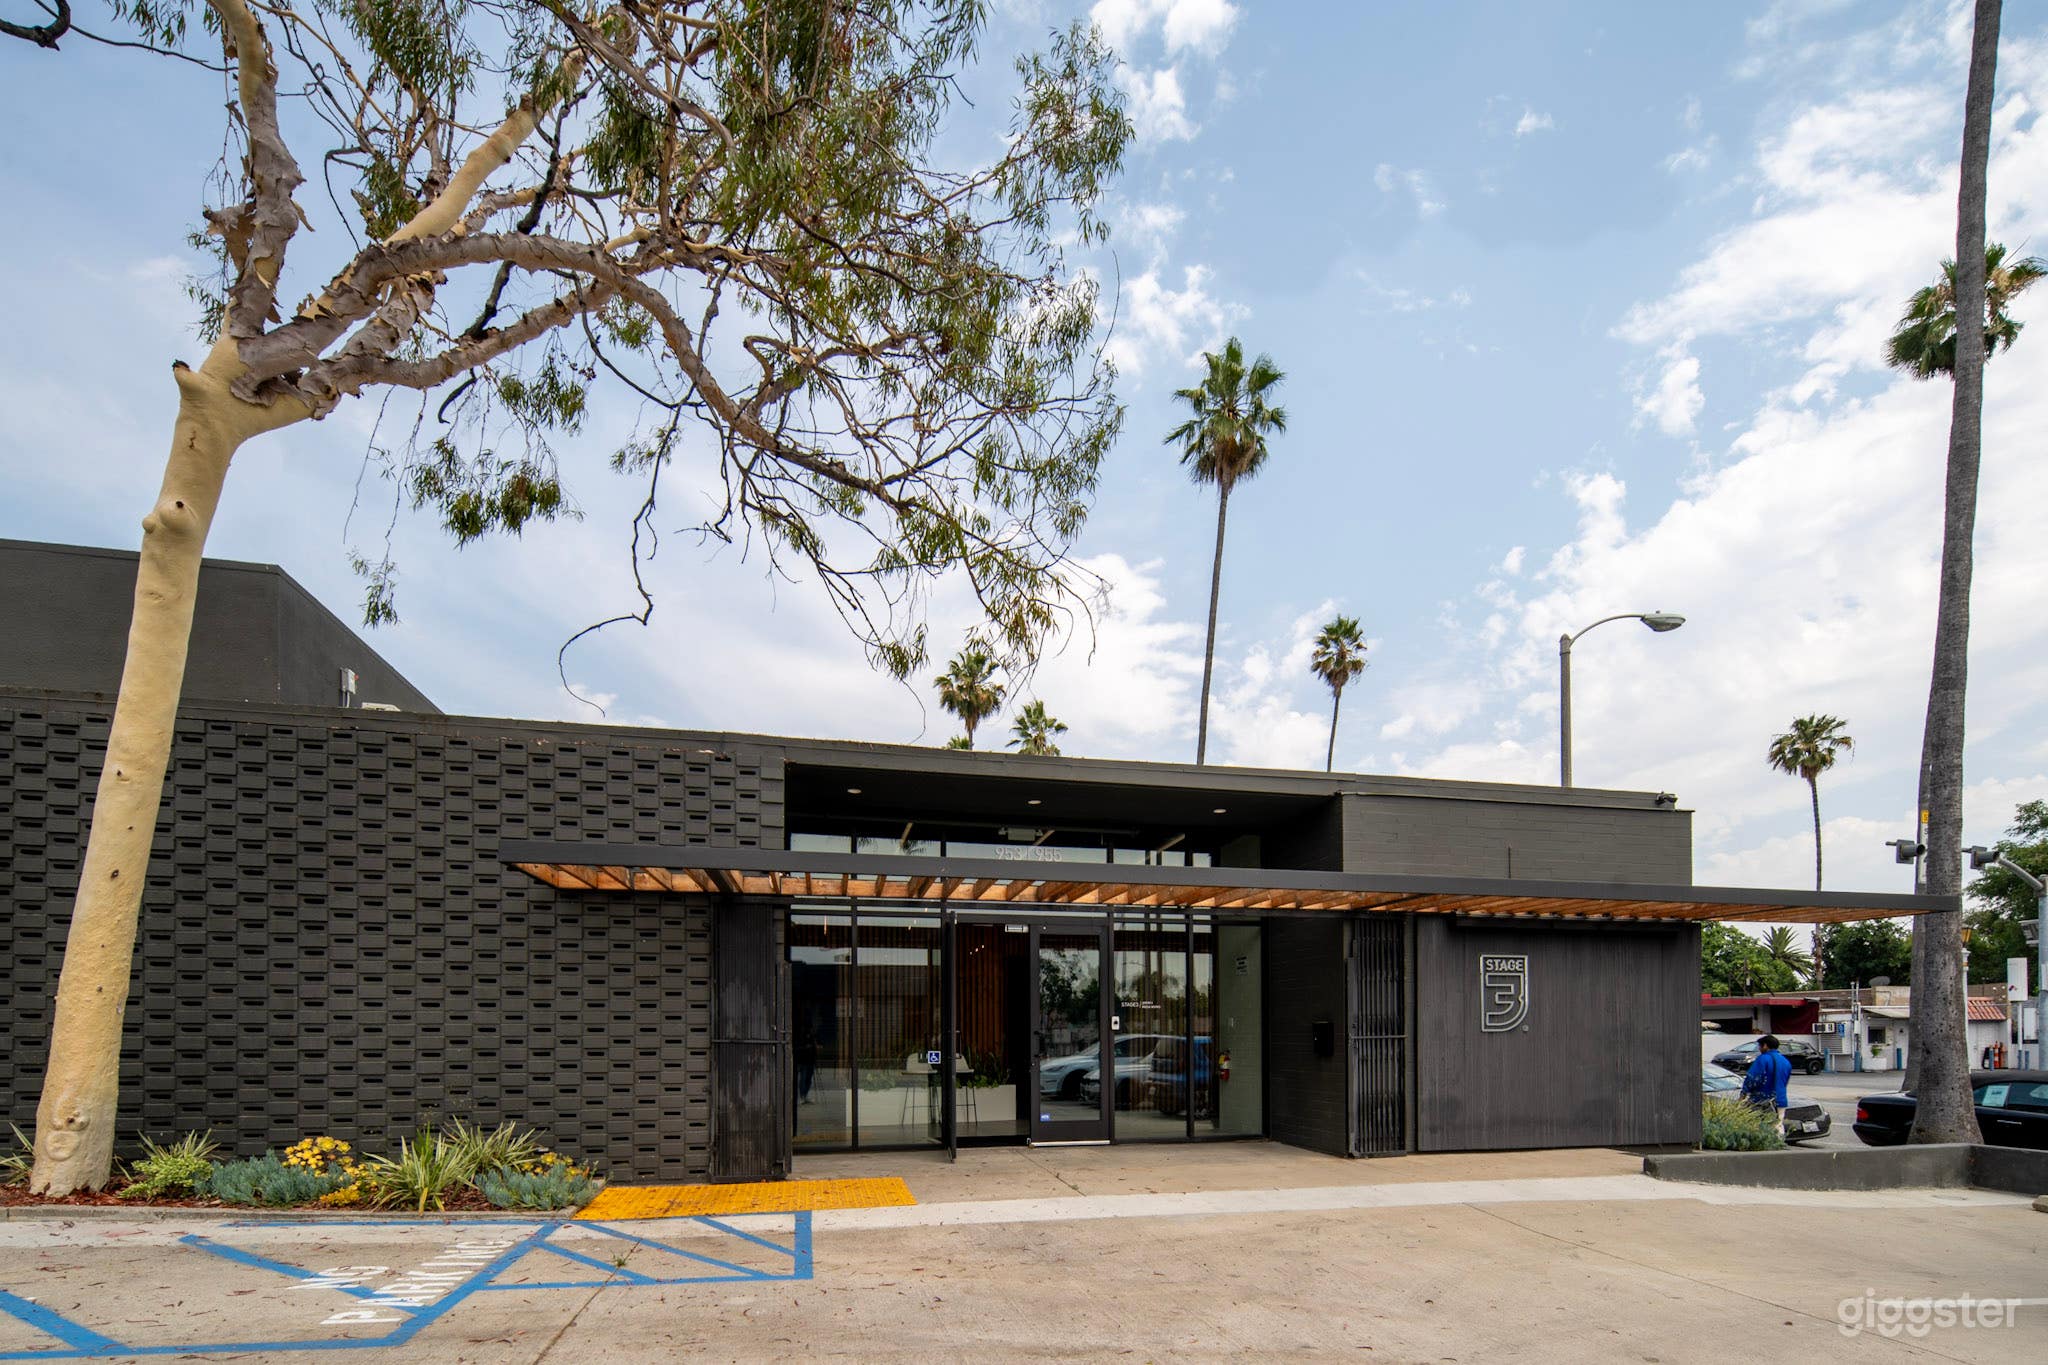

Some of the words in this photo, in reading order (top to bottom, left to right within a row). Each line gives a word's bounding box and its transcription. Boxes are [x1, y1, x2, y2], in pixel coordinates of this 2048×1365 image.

[1486, 959, 1524, 971] STAGE
[1485, 973, 1525, 1026] 3
[287, 1265, 390, 1290] NO
[320, 1240, 514, 1325] PARKING
